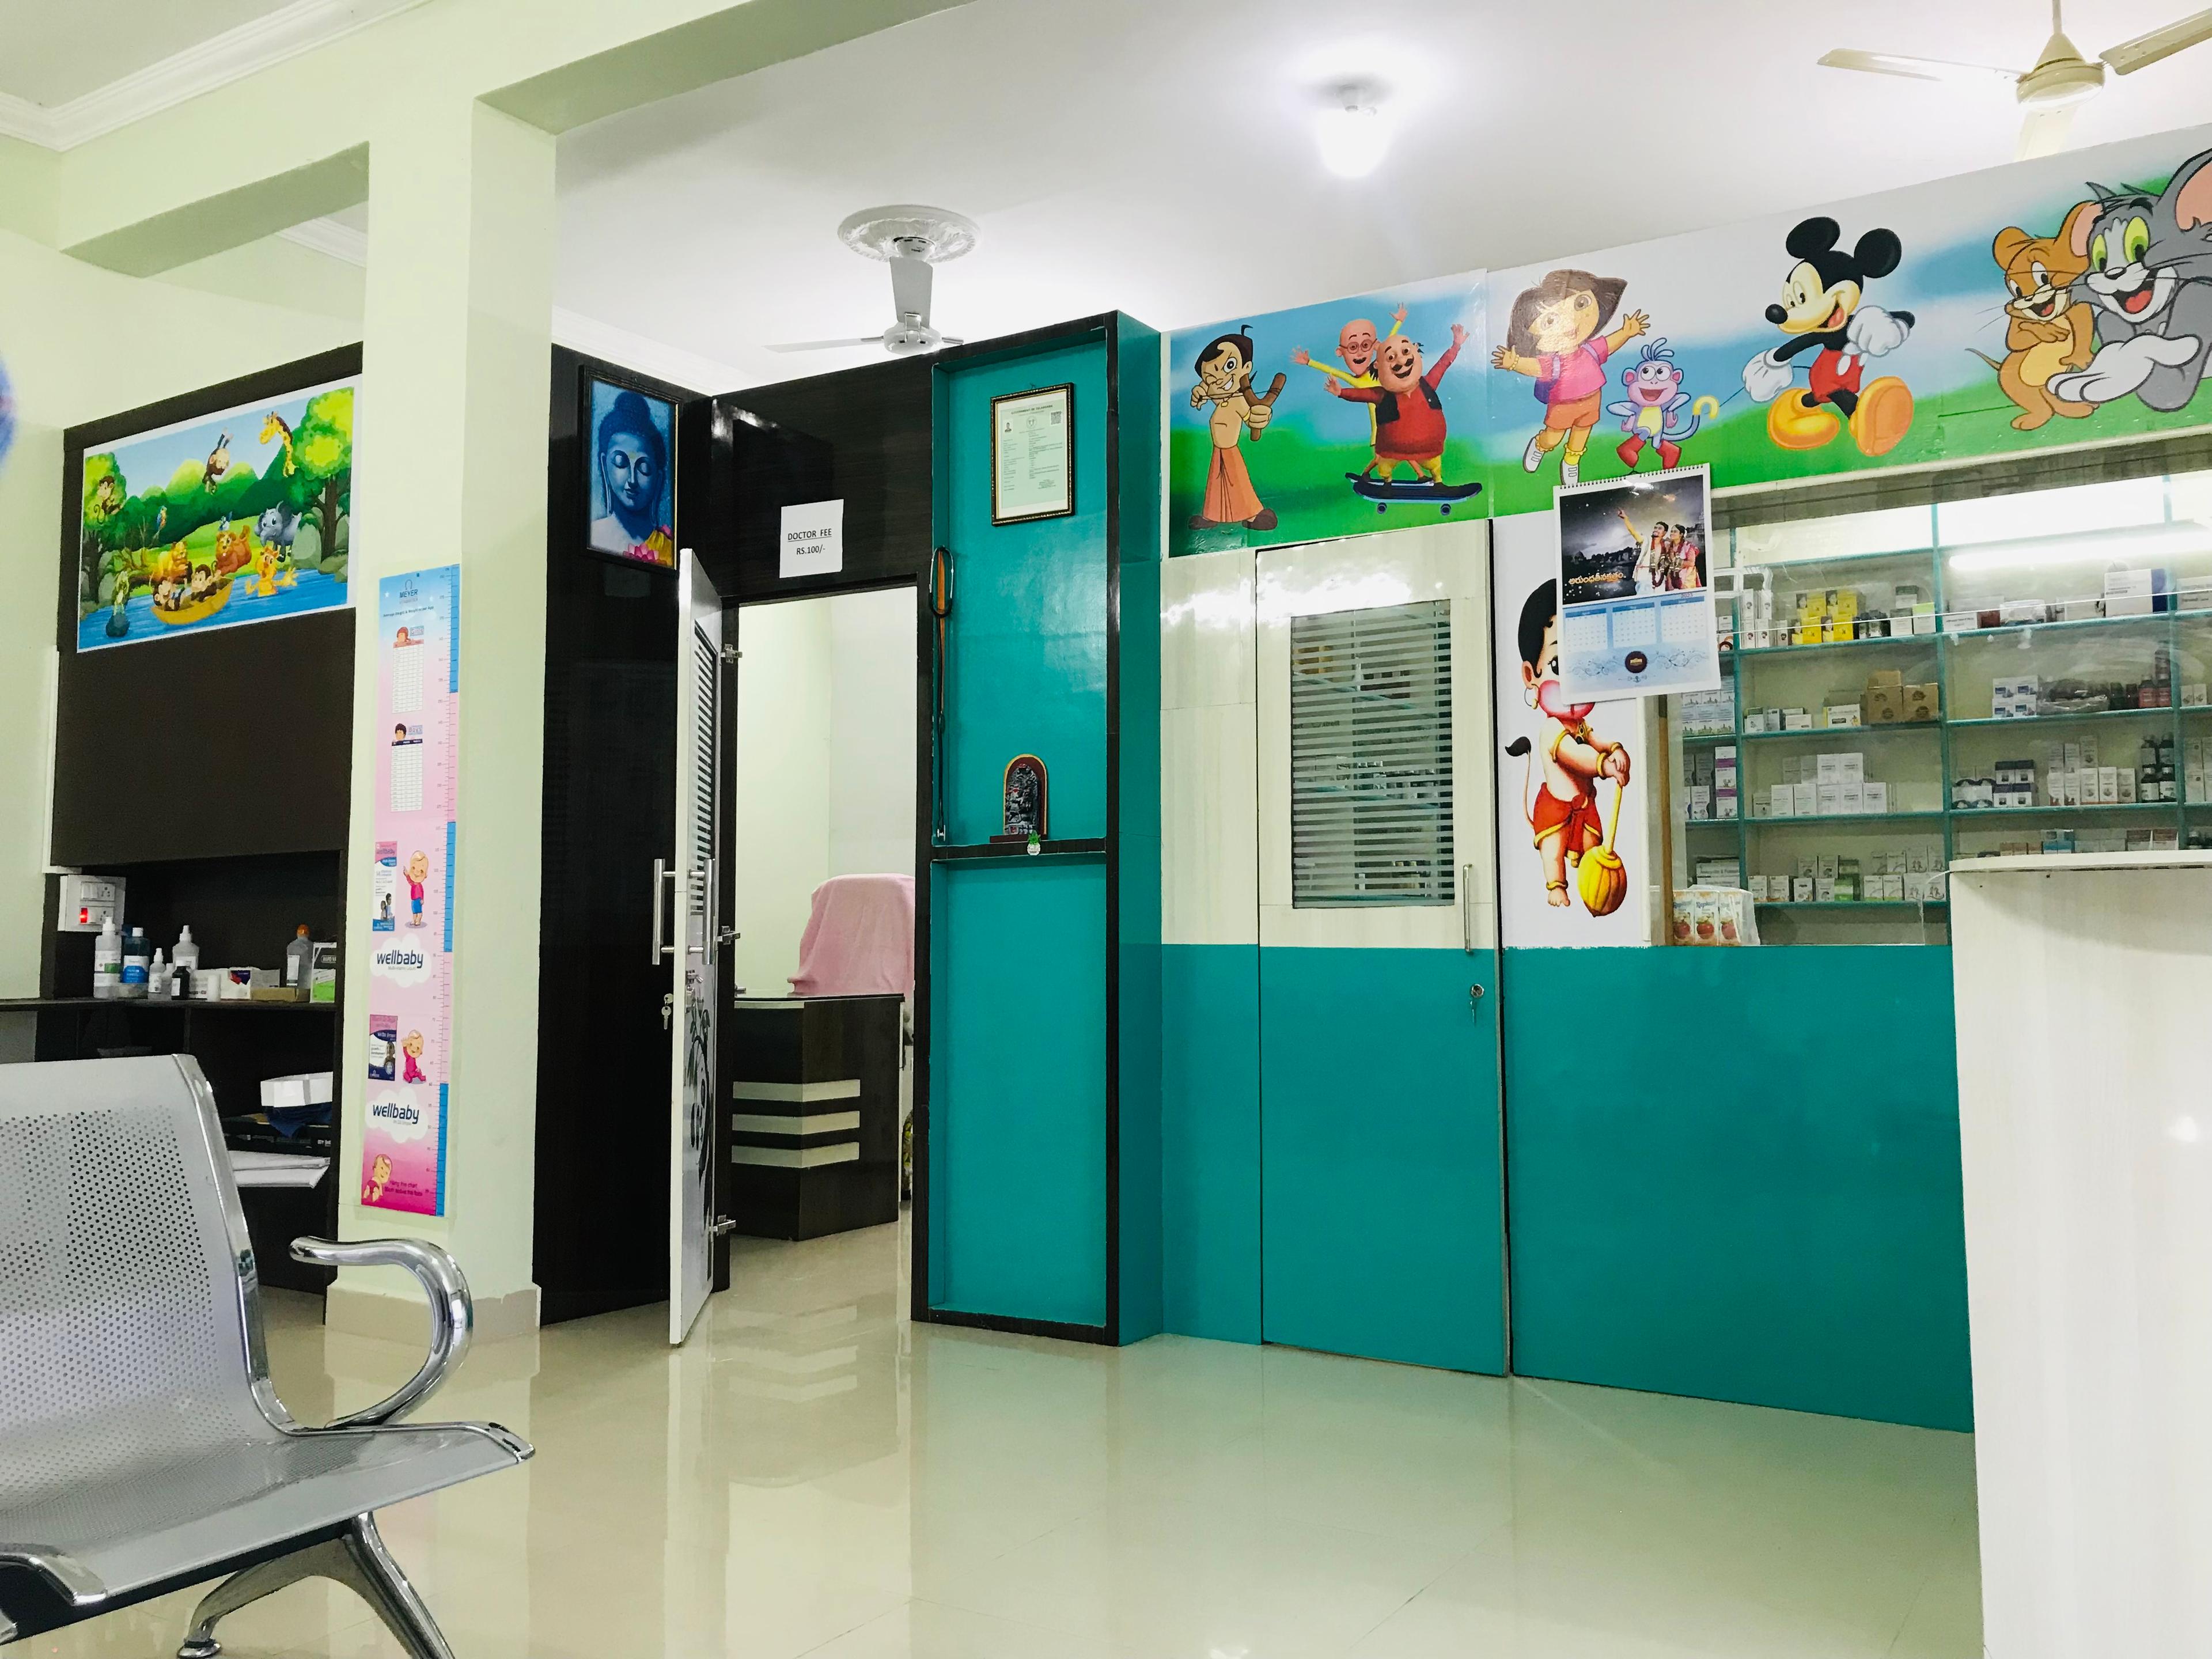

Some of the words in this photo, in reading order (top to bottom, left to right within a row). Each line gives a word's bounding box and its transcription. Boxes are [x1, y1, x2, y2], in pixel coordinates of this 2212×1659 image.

[788, 530, 816, 540] DOCTOR
[820, 528, 832, 536] FEE
[796, 544, 825, 555] RS.100/-
[399, 589, 418, 598] MEYER
[377, 949, 423, 969] wellbaby
[373, 1103, 419, 1124] wellbaby
